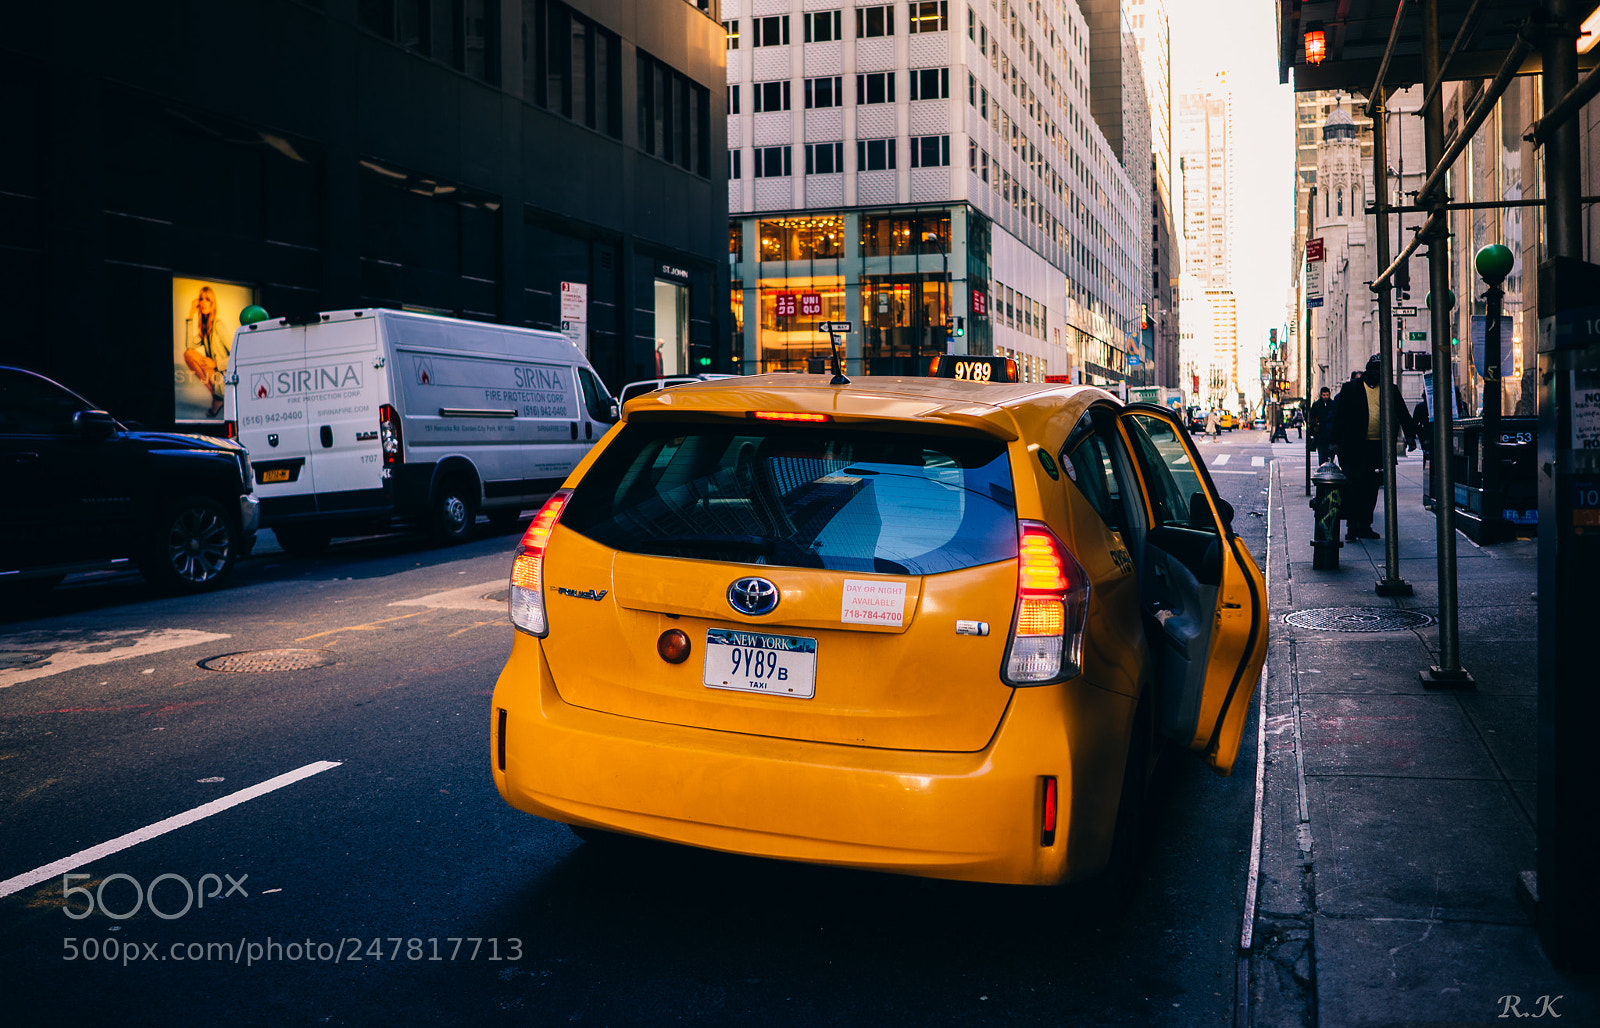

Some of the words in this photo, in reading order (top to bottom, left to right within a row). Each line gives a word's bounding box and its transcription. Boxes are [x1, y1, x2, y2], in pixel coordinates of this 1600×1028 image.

[671, 267, 688, 278] JOHN
[803, 296, 818, 304] UNI
[803, 305, 820, 314] QLO
[175, 370, 196, 383] ST
[955, 361, 991, 382] 9Y89
[277, 365, 360, 394] SIRINA
[514, 367, 564, 389] SIRINA
[303, 393, 342, 402] PROTECTION
[485, 390, 501, 400] FIRE
[503, 391, 546, 402] PROTECTION
[547, 393, 566, 403] CORP.
[523, 405, 540, 416] (516)
[541, 406, 567, 416] 942-0400
[242, 415, 263, 426] (516)
[265, 411, 303, 421] 942-0400
[361, 455, 378, 464] 1707
[1506, 510, 1532, 519] FRE
[846, 584, 861, 592] DAY
[863, 586, 876, 594] OR
[877, 586, 903, 595] NIGHT
[851, 597, 896, 608] AVAILABLE
[843, 609, 902, 621] 718-784-4700
[733, 632, 758, 646] NEW
[761, 635, 790, 650] YORK
[731, 647, 778, 680] 9Y89
[777, 666, 789, 681] B
[749, 680, 768, 689] TAXI
